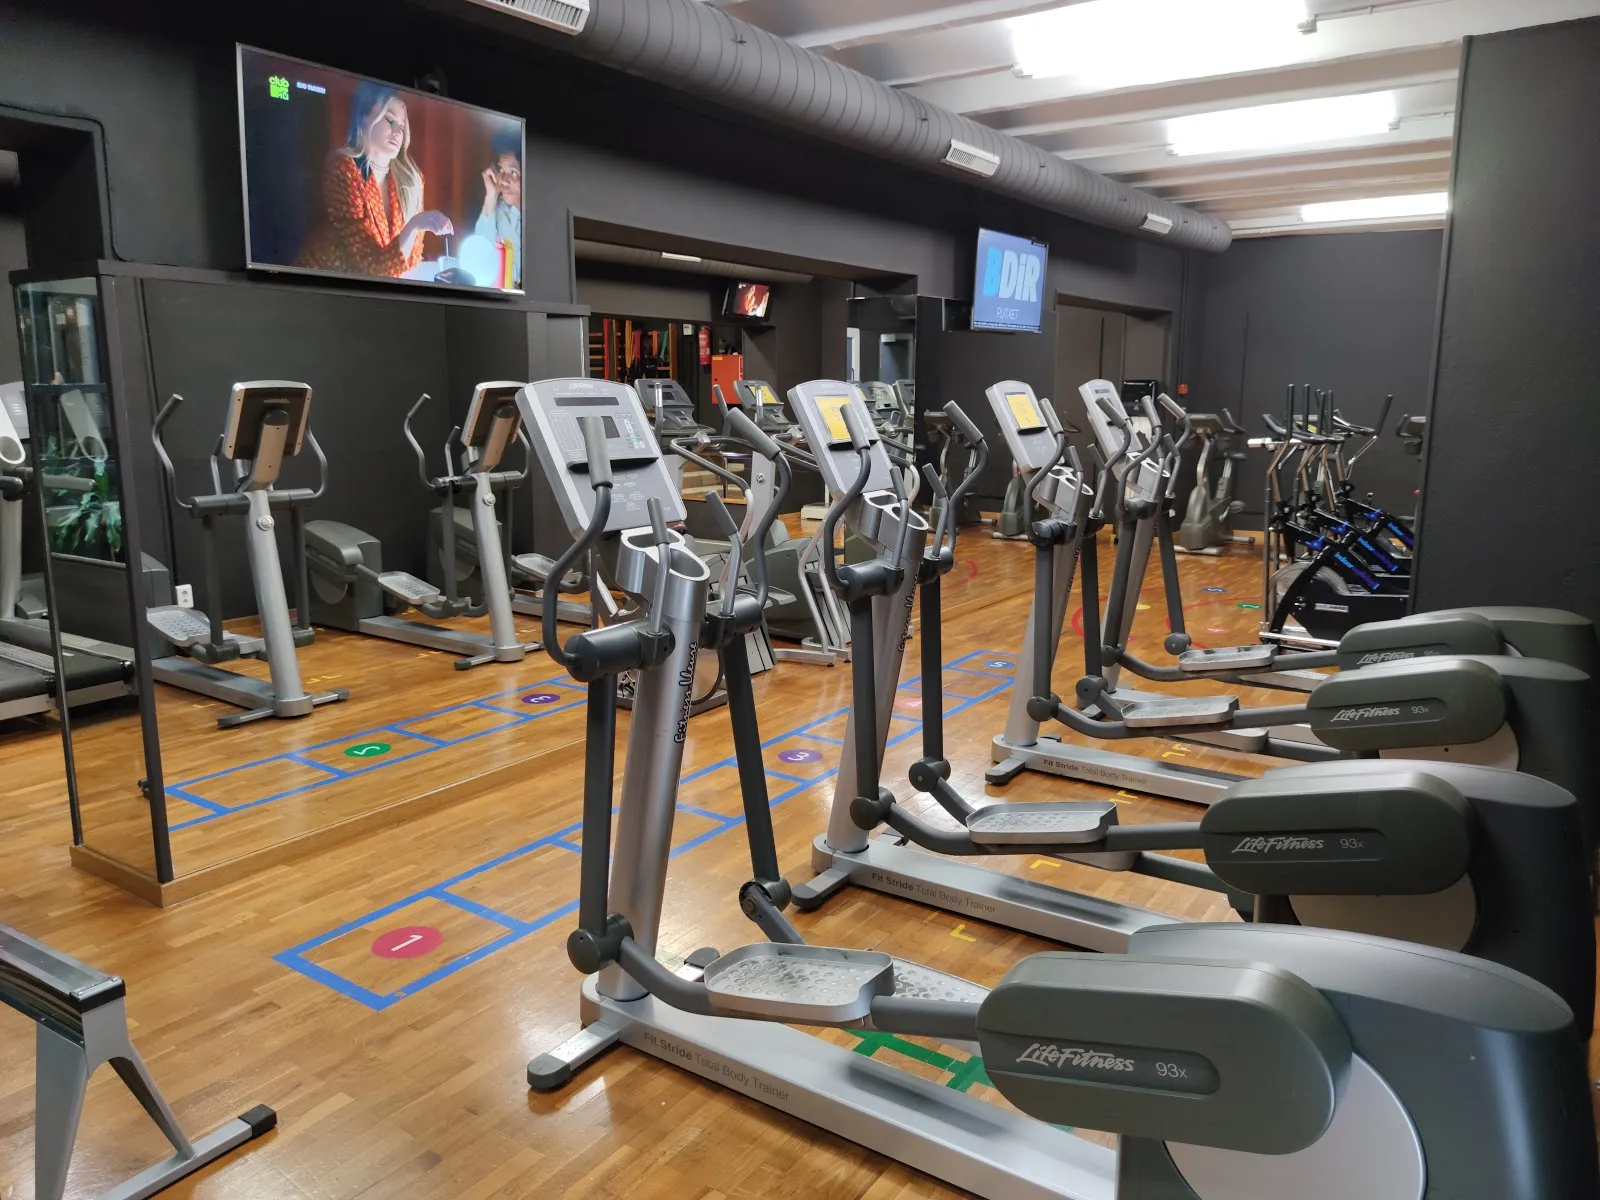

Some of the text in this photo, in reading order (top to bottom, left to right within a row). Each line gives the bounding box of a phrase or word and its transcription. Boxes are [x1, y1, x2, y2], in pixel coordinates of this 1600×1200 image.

[269, 76, 290, 88] club
[788, 752, 810, 761] 3
[1043, 758, 1054, 767] Fit
[1056, 761, 1079, 772] Stride
[1080, 766, 1099, 776] Total
[1100, 770, 1120, 781] Body
[1340, 838, 1364, 850] 93x
[872, 872, 996, 913] Fit Stride Total Body Trainer
[391, 935, 423, 951] 1
[644, 1031, 790, 1102] Fit Stride Total Body Trainer
[1156, 1062, 1188, 1079] 93x
